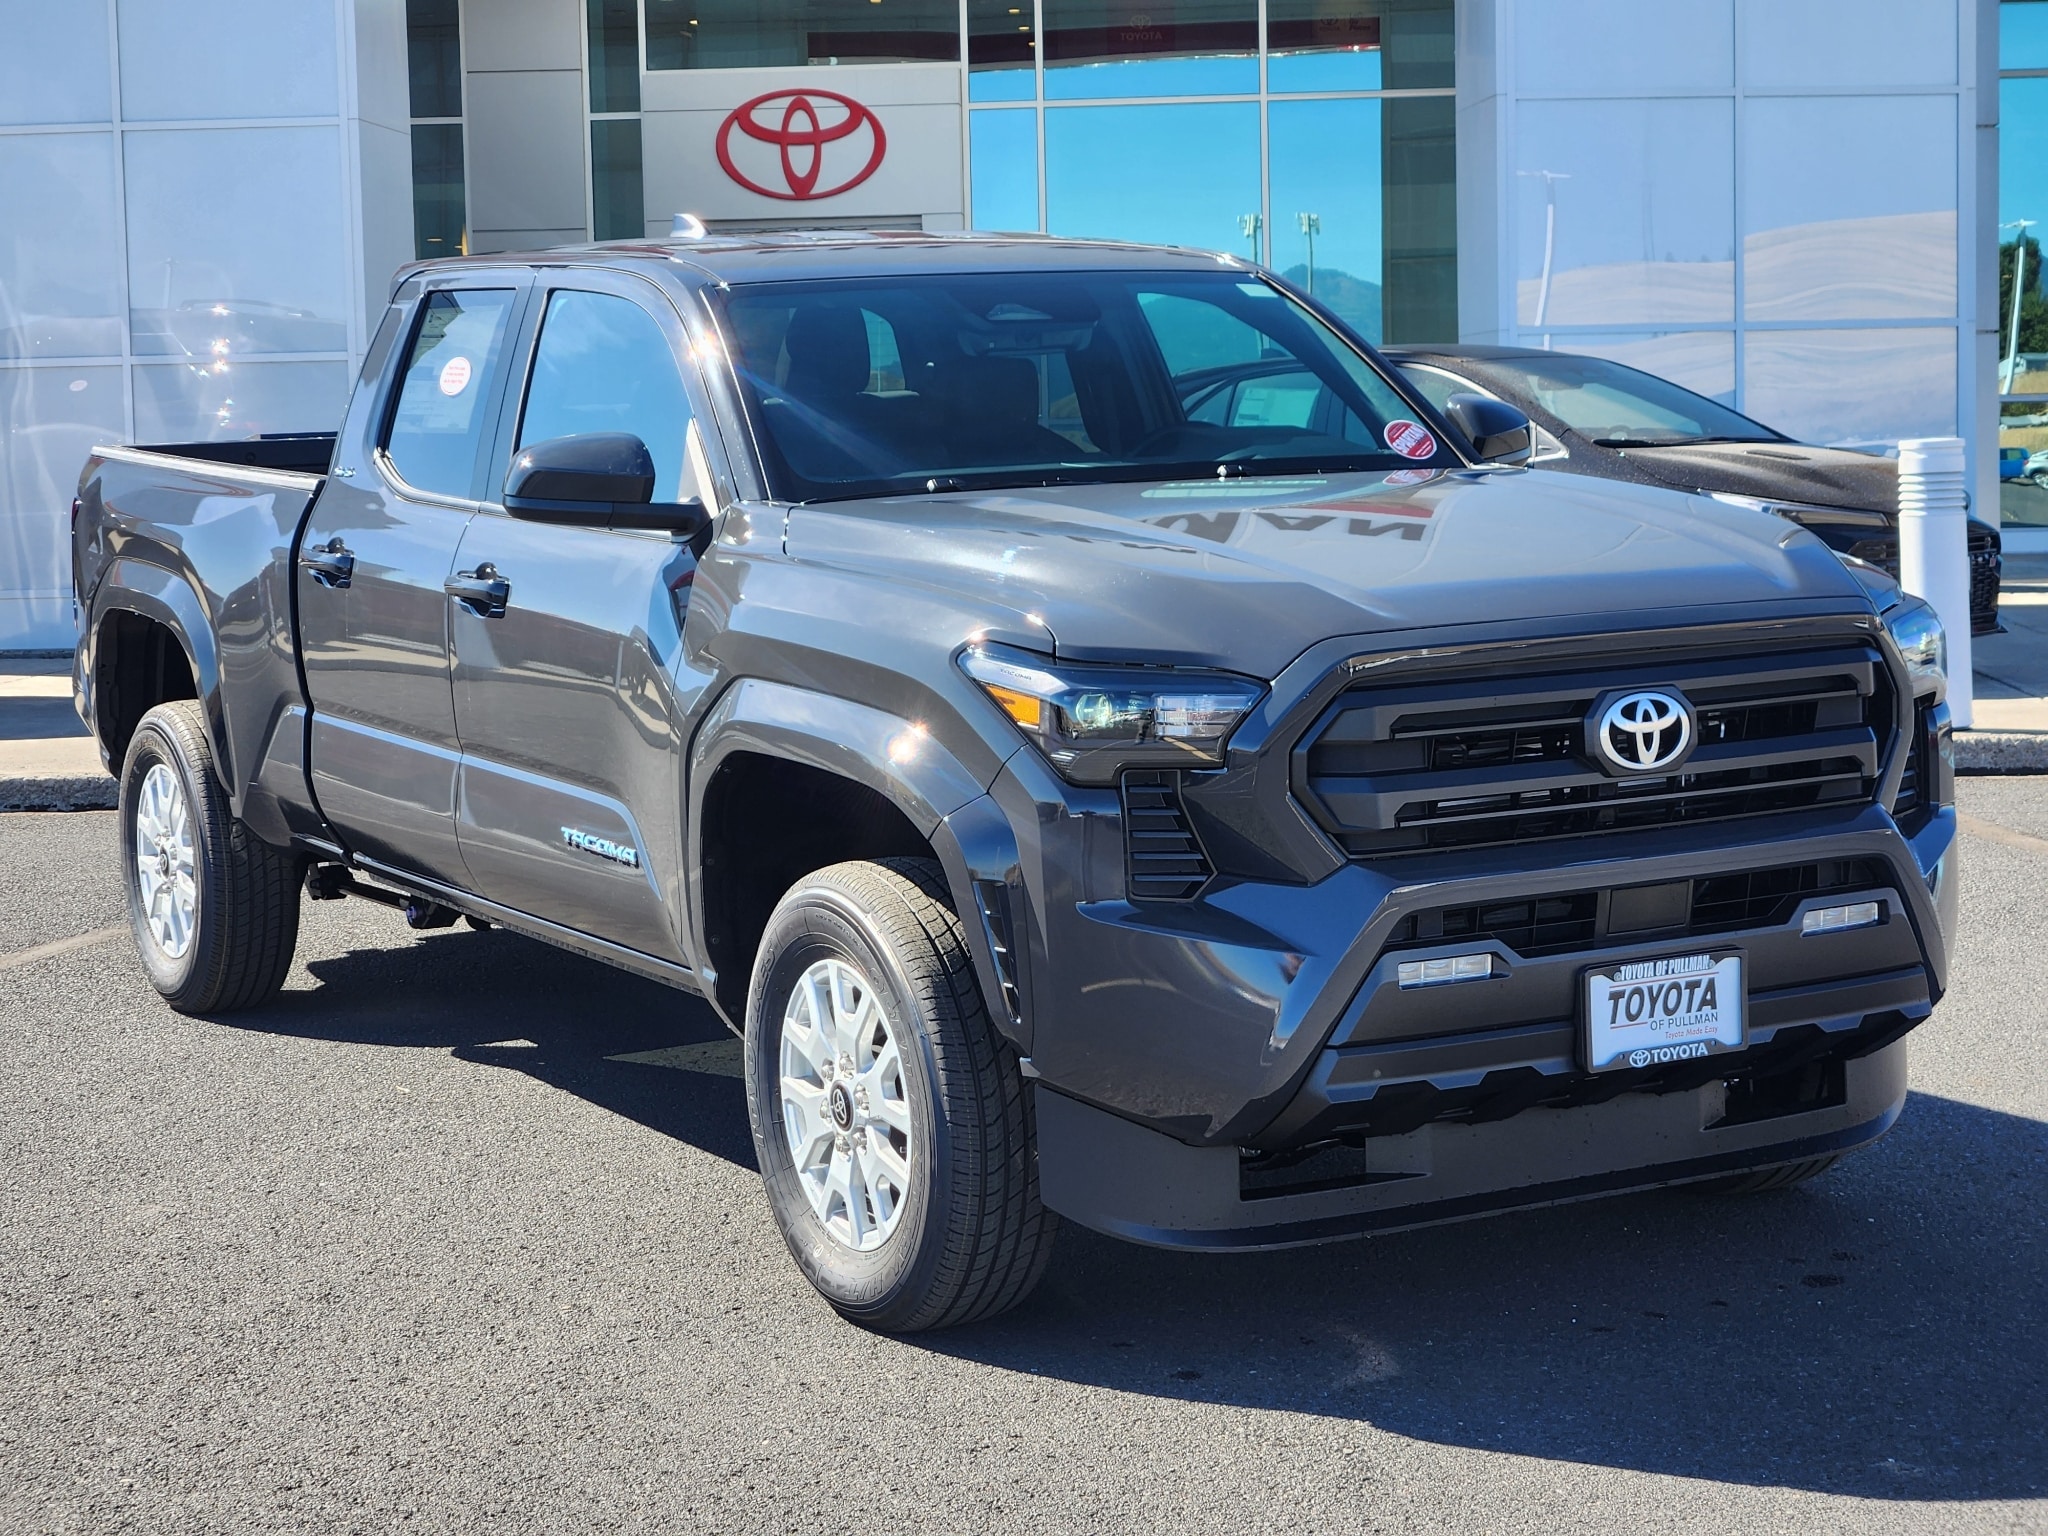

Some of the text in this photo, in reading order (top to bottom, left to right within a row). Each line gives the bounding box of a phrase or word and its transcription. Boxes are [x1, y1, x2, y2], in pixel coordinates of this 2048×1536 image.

[1120, 32, 1163, 41] TOYOTA
[561, 826, 638, 867] TACOMA
[1620, 954, 1710, 981] TOYOTA OF PULLMAN
[1608, 976, 1718, 1025] TOYOTA
[1650, 1012, 1718, 1031] OF PULLMAN
[1665, 1025, 1718, 1040] Toyota Made Easy
[1651, 1042, 1708, 1063] TOYOTA
